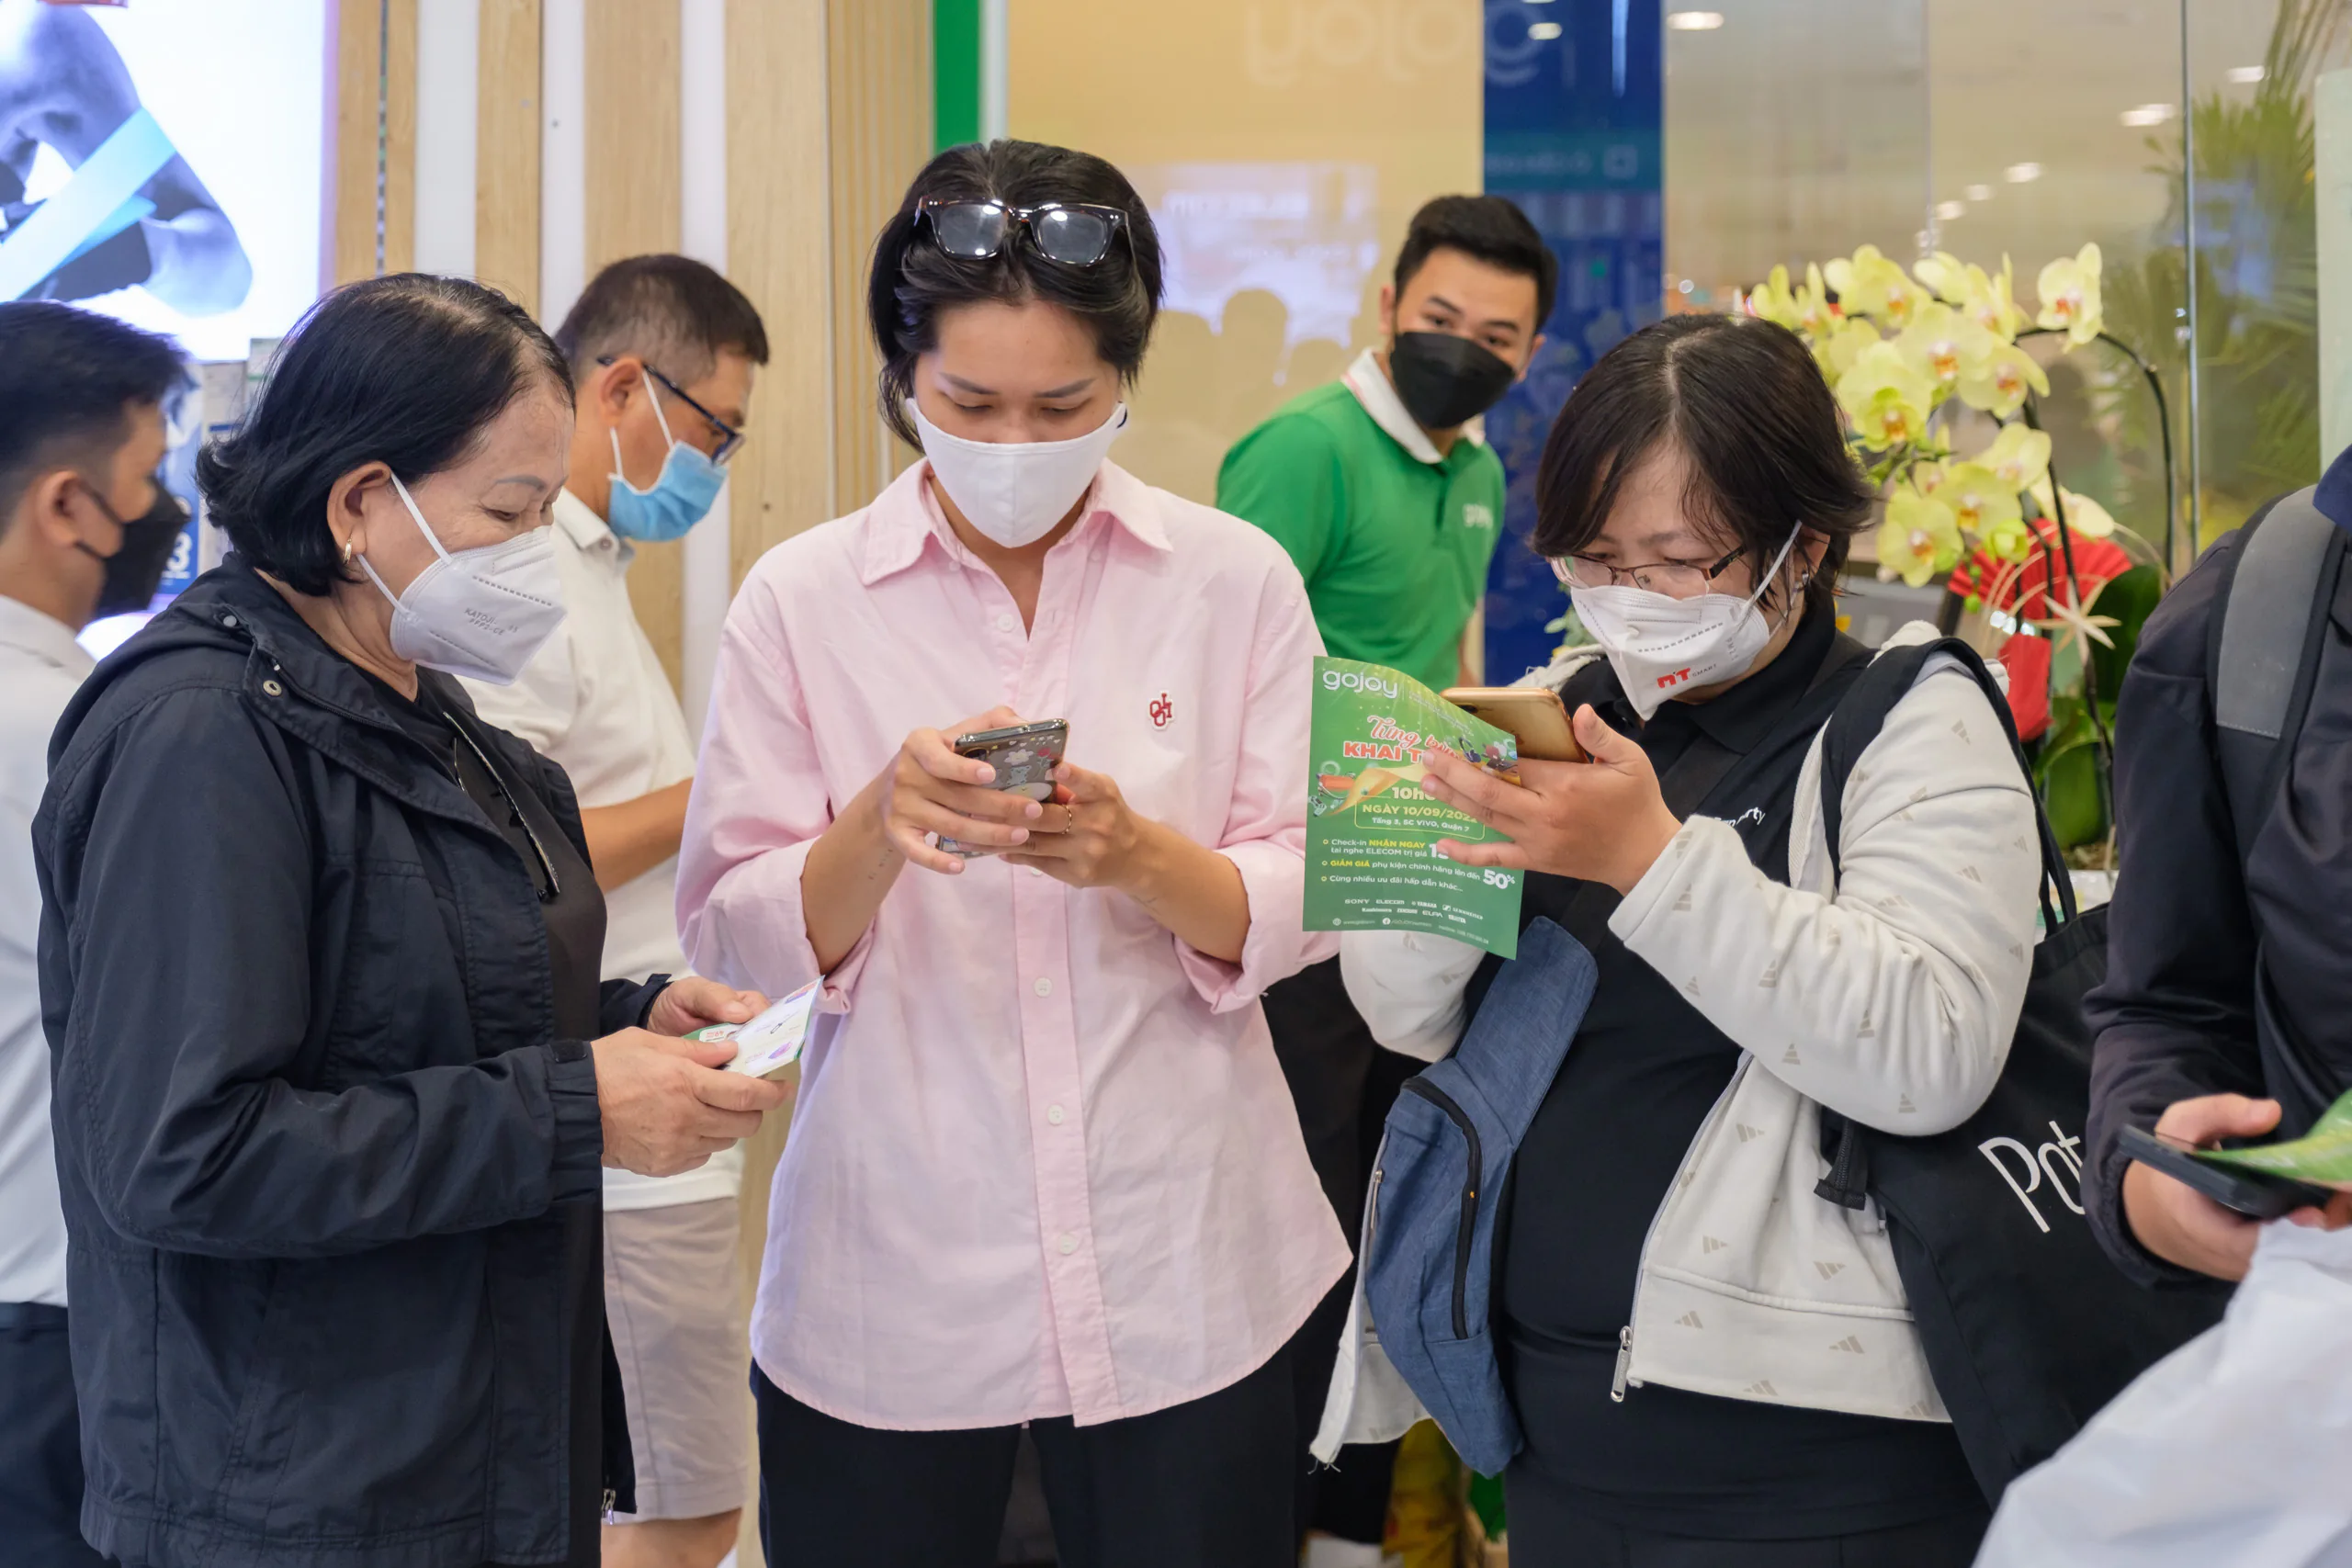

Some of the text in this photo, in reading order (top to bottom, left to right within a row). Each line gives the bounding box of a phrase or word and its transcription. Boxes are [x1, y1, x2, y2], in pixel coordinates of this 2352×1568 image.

[1323, 670, 1397, 698] gojoy
[1343, 740, 1402, 761] KHAI
[1363, 804, 1400, 814] NGÀY
